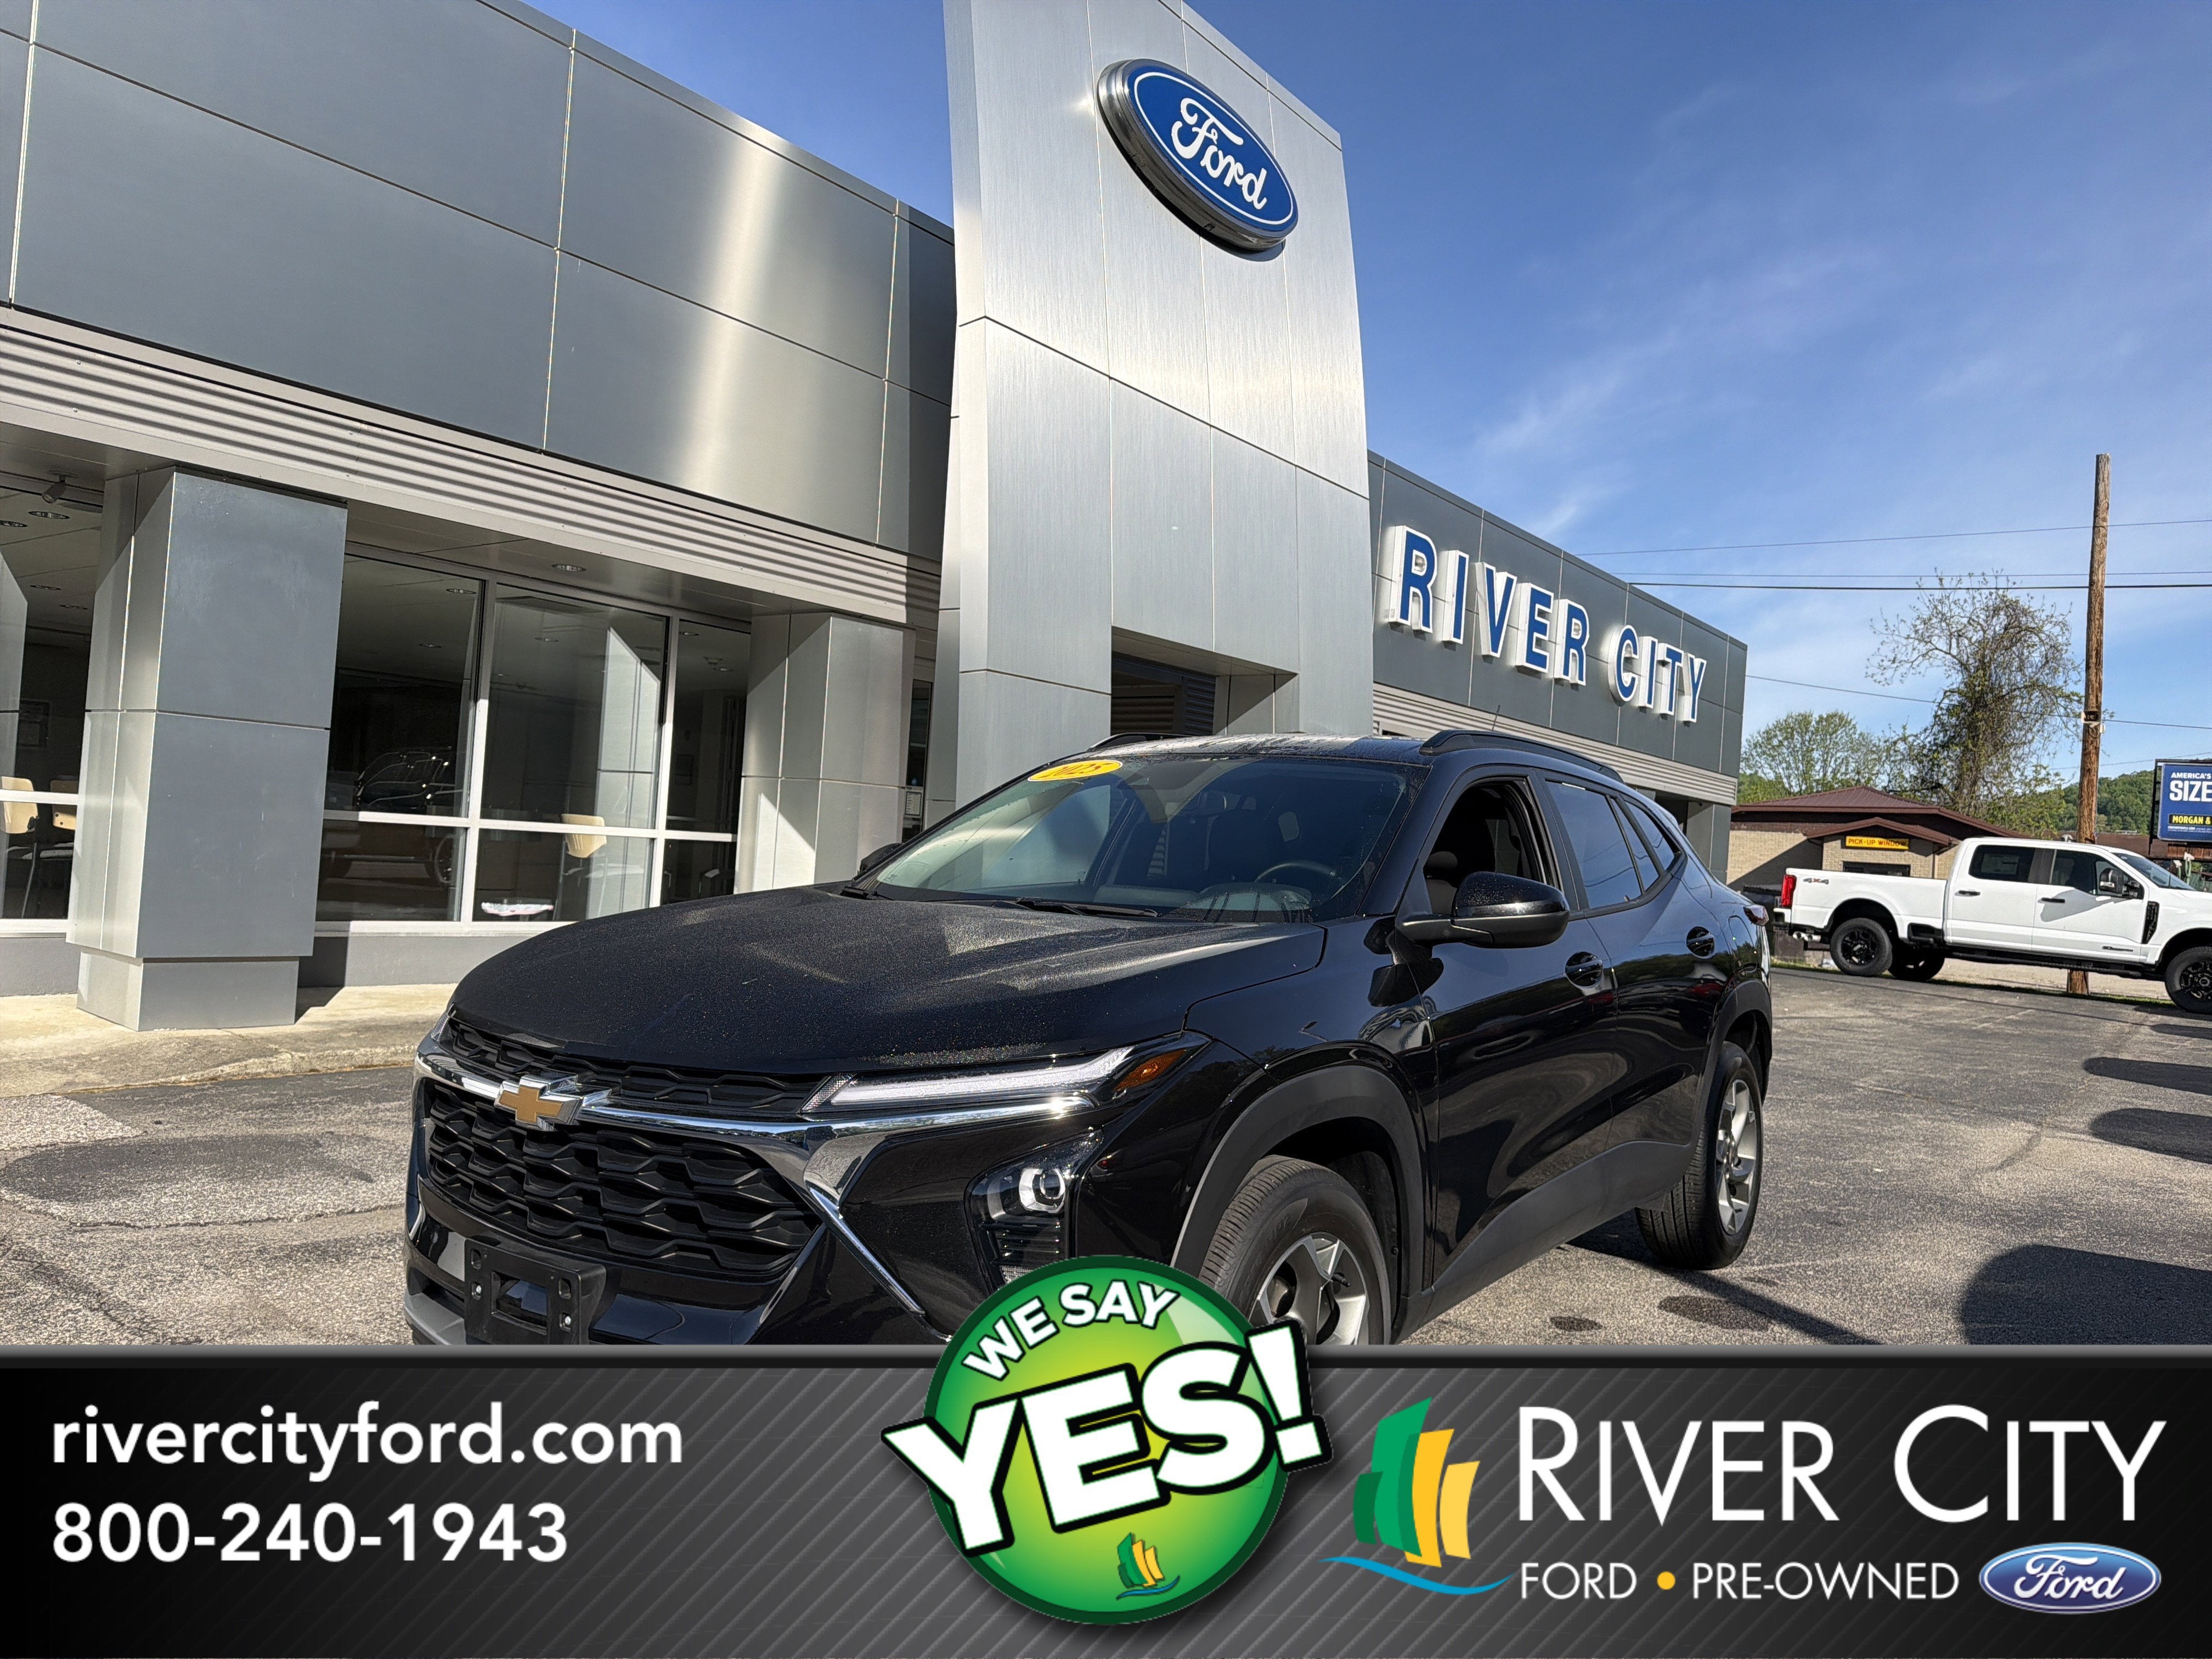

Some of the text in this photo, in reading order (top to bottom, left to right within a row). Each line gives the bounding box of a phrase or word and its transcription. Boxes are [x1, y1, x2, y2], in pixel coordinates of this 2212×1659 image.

[1171, 98, 1267, 210] Ford
[1389, 524, 1707, 723] RIVER CITY
[2169, 780, 2212, 802] SIZE
[2172, 815, 2211, 825] MORGAN &
